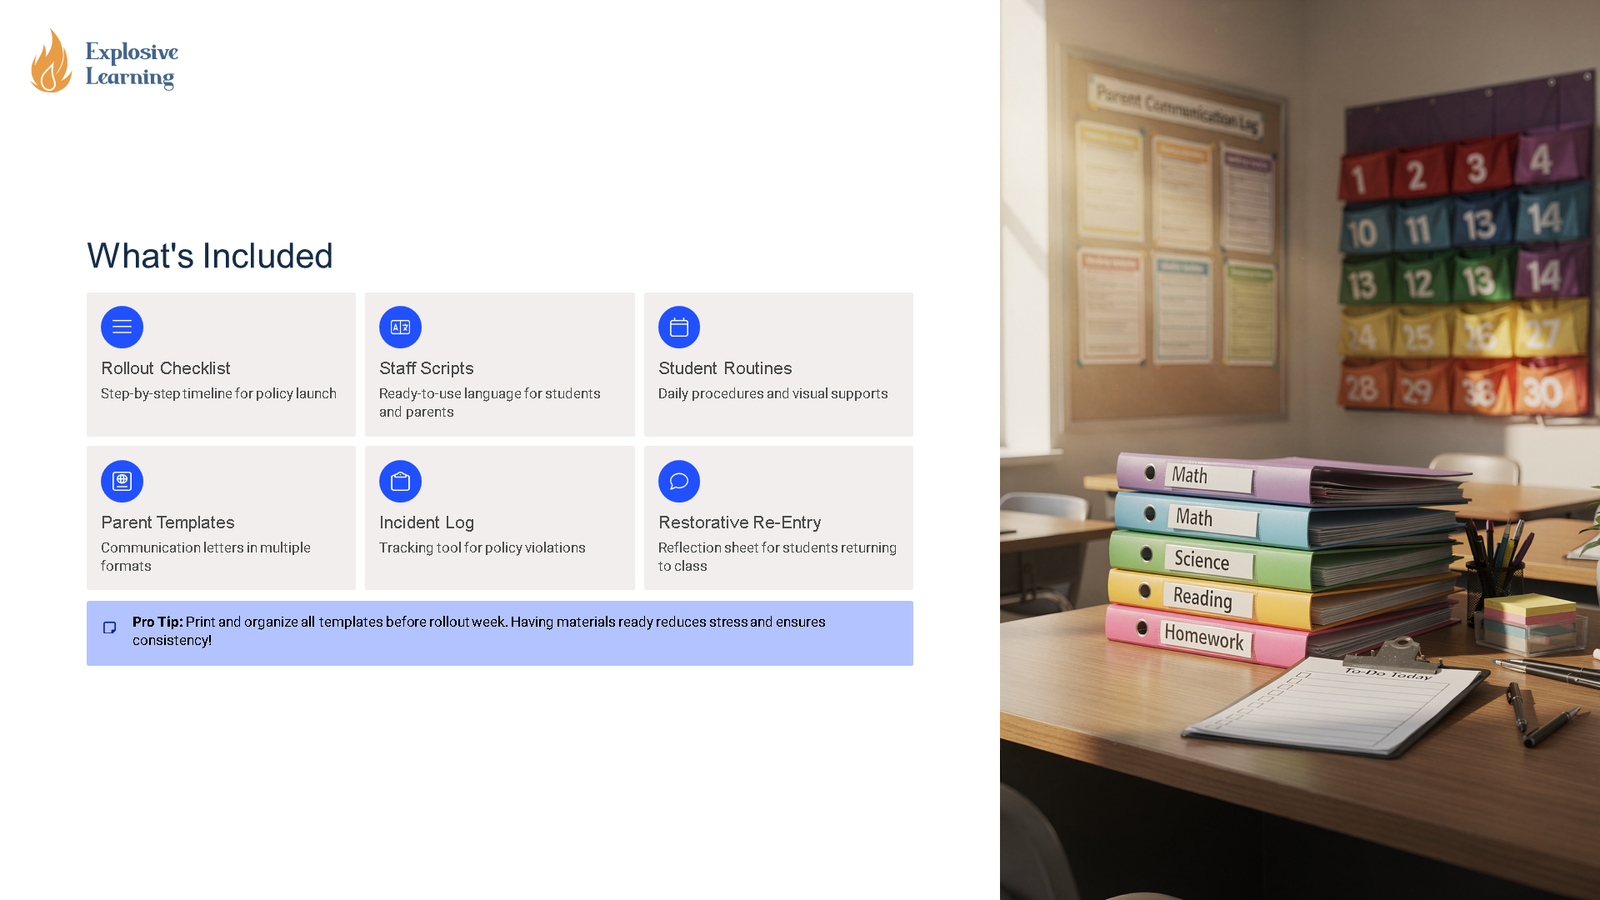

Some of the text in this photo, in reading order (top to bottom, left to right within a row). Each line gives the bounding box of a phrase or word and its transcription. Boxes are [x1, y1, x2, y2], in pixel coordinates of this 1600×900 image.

[1096, 84, 1261, 135] Parent Communication Log
[1467, 153, 1488, 184] 3
[1530, 143, 1553, 175] 4
[1351, 165, 1367, 195] 1
[1406, 160, 1427, 191] 2
[1347, 218, 1379, 248] 10
[1405, 214, 1431, 245] 11
[1463, 209, 1497, 241] 13
[1526, 202, 1563, 235] 14
[1348, 269, 1378, 300] 13
[1404, 269, 1435, 299] 12
[1462, 265, 1496, 297] 13
[1527, 259, 1562, 293] 14
[1347, 323, 1377, 351] 24
[1403, 324, 1434, 351] 25
[1464, 323, 1498, 351] 26
[1526, 318, 1561, 349] 27
[1346, 374, 1379, 402] 28
[1401, 378, 1433, 405] 29
[1523, 375, 1564, 409] 30
[1172, 466, 1208, 484] Math
[1176, 507, 1213, 527] Math
[1175, 549, 1230, 571] Science
[1173, 586, 1233, 614] Reading
[1165, 622, 1244, 651] Homework
[1345, 667, 1433, 681] To-Do Today
